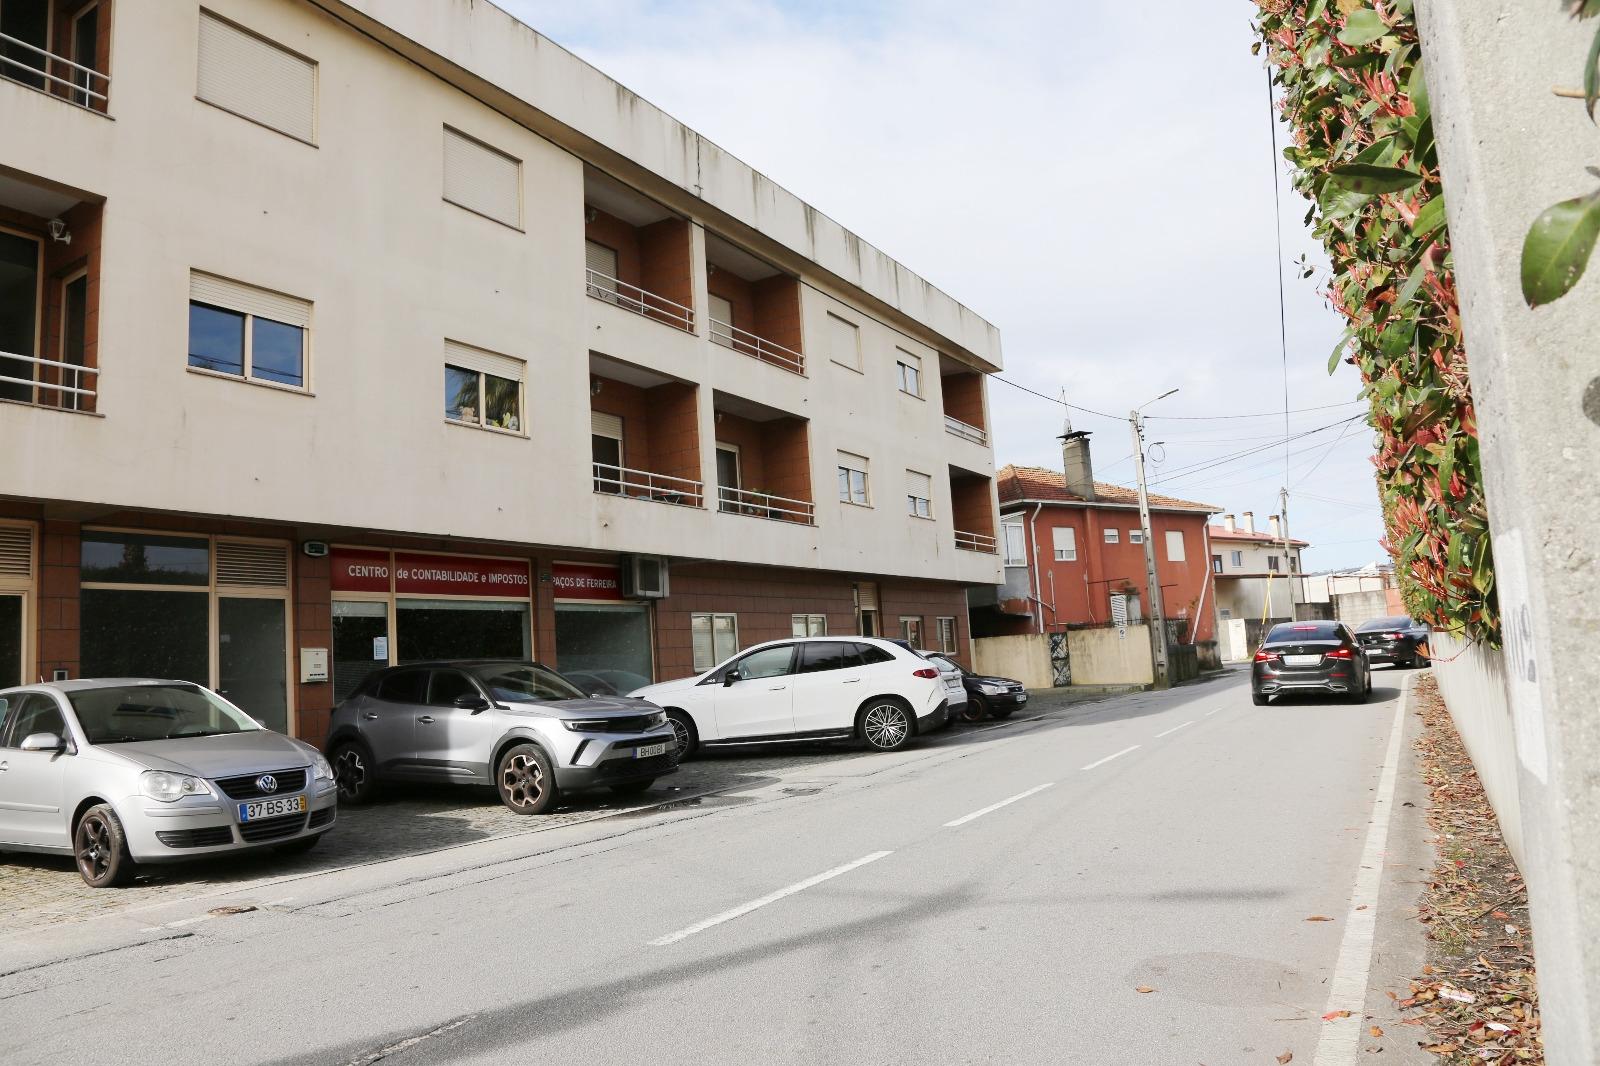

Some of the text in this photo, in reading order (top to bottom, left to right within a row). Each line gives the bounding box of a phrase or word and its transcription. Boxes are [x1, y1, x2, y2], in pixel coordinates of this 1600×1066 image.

[348, 565, 528, 585] CENTRO de CONTABILIDADE e IMPOSTOS
[576, 578, 586, 588] DE
[586, 578, 617, 589] FERREIRA
